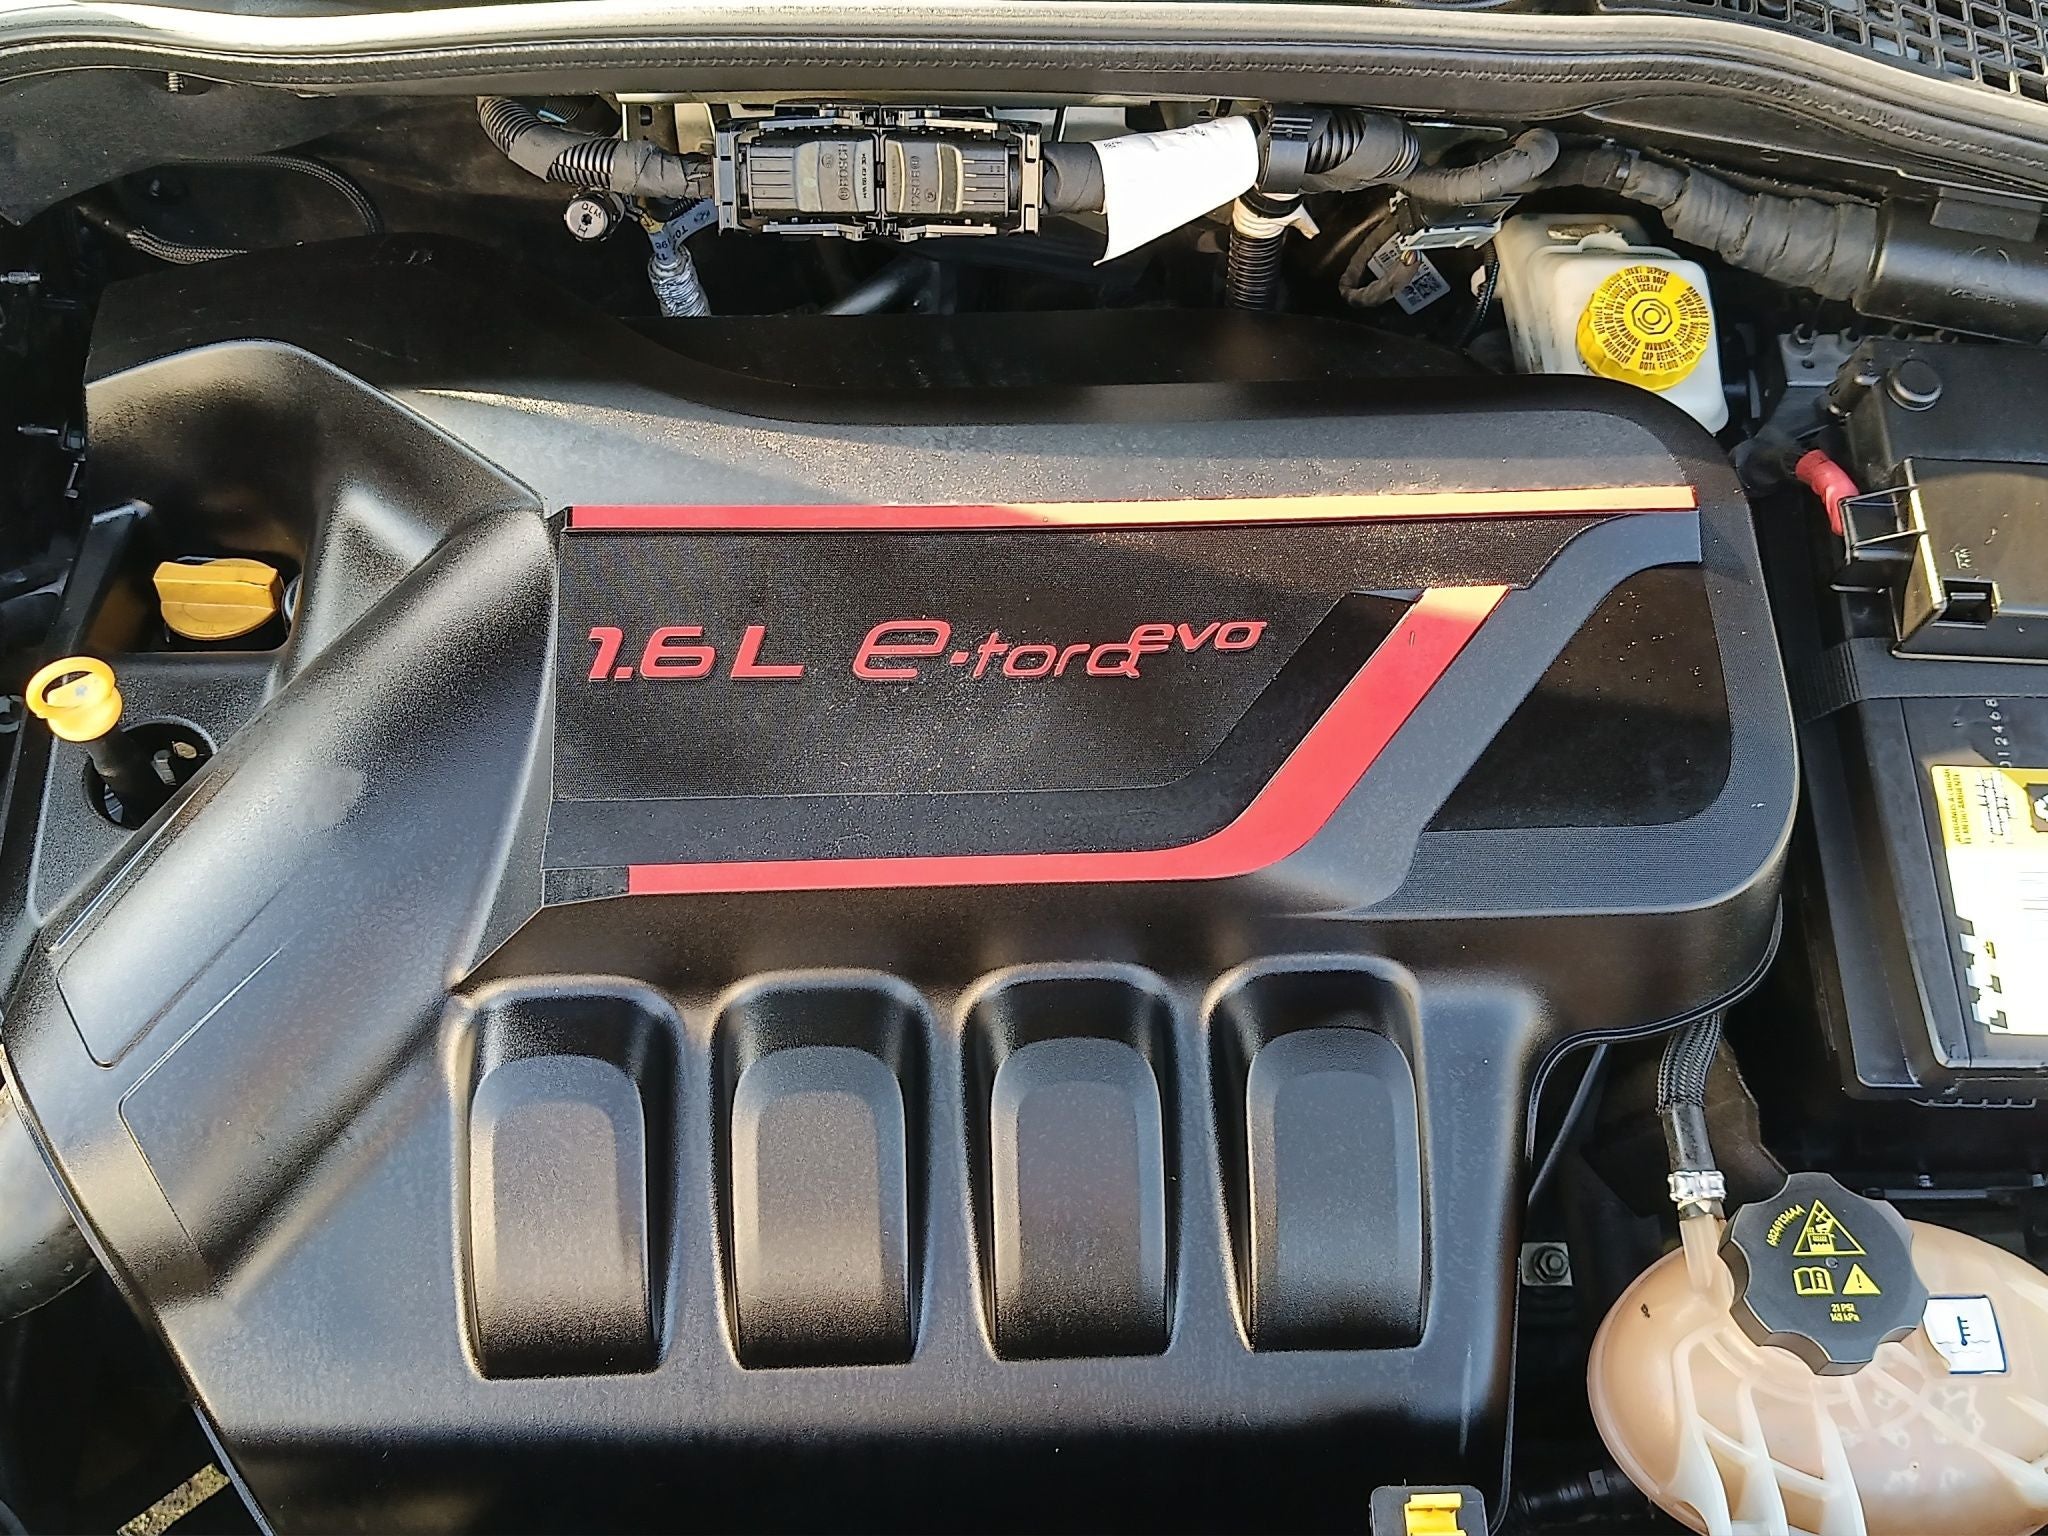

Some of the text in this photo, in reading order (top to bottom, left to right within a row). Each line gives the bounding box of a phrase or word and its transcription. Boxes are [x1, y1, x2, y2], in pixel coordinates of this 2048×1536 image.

[838, 143, 849, 188] BOSCH
[1642, 351, 1654, 361] CAP
[586, 623, 718, 683] 1.6
[730, 624, 805, 682] L
